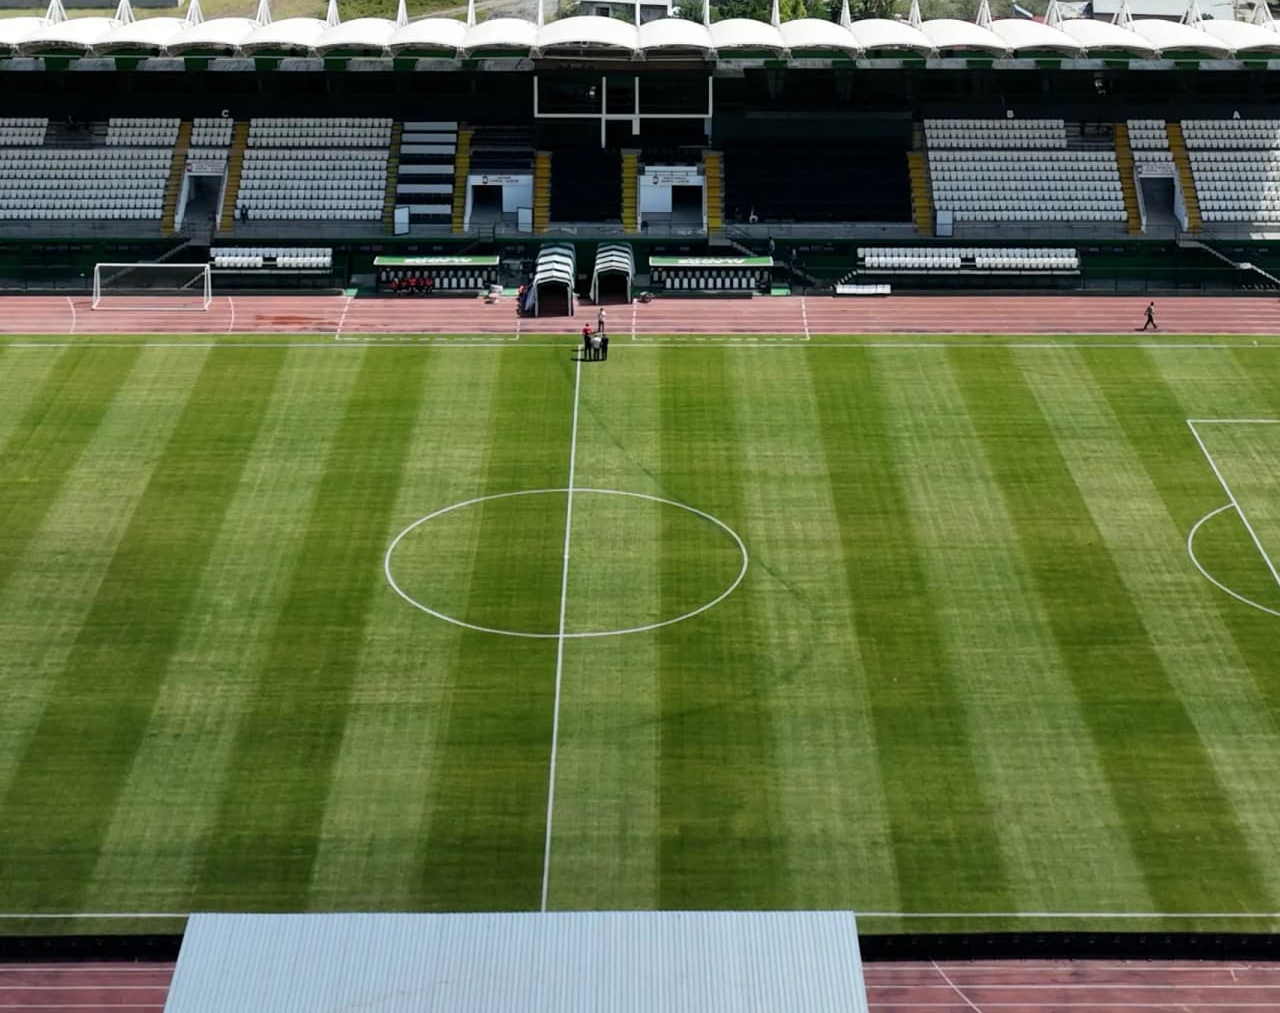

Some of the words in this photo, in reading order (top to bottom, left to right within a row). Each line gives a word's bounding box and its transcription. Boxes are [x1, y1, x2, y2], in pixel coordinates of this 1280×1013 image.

[221, 109, 229, 118] C
[1006, 109, 1014, 118] B
[1232, 110, 1241, 120] A
